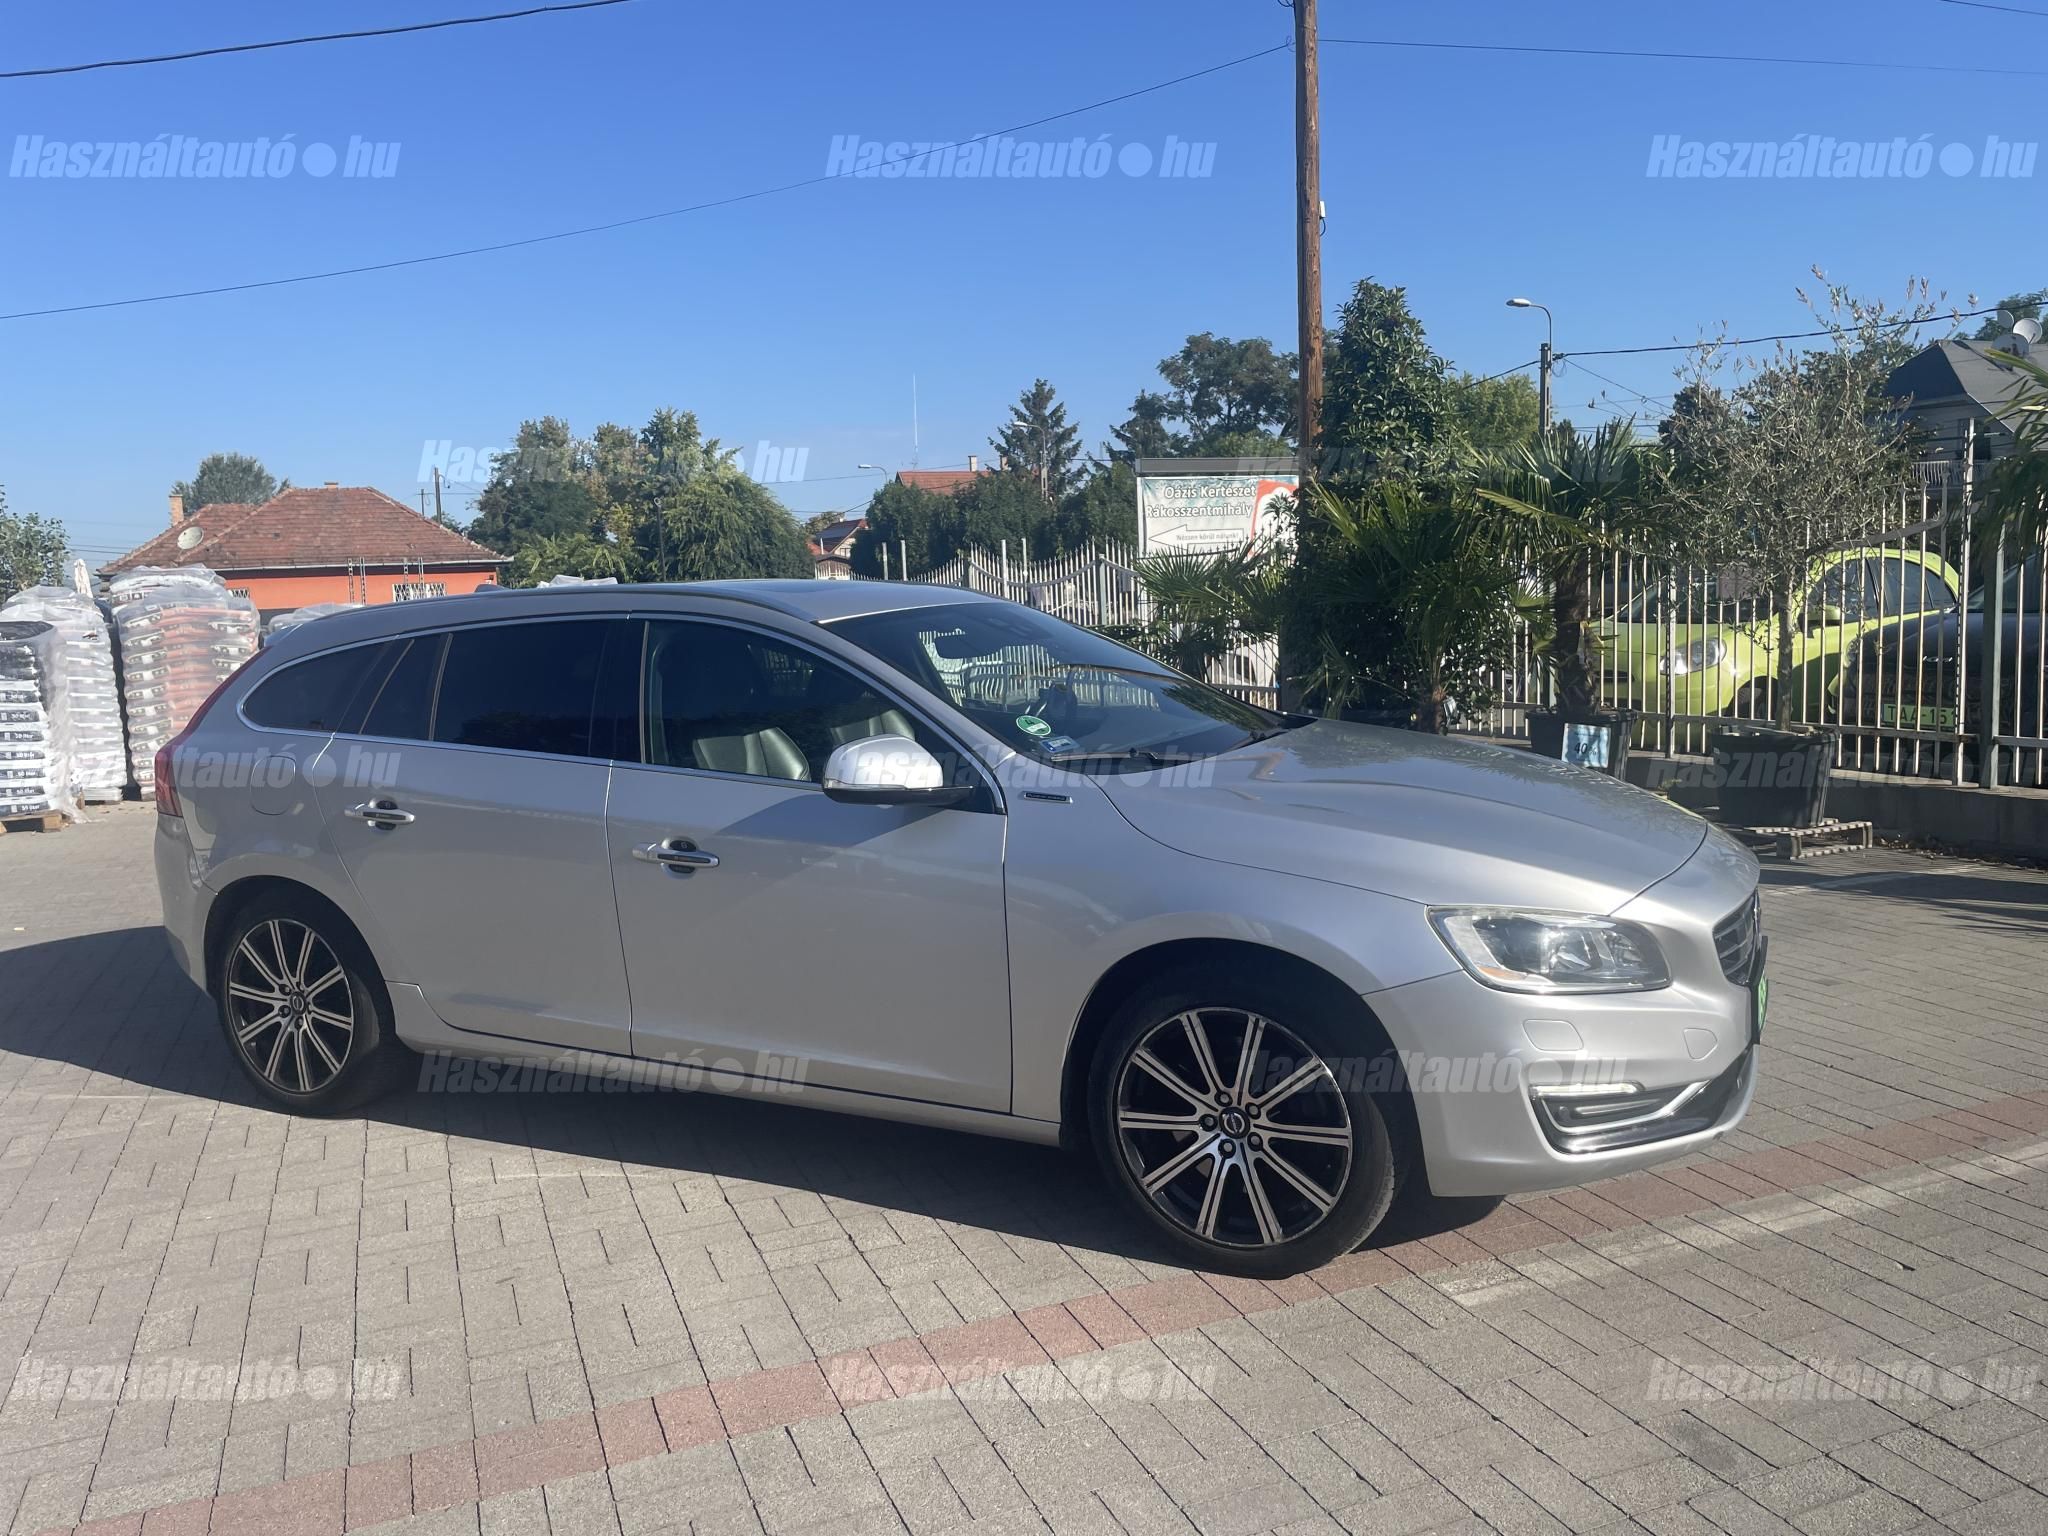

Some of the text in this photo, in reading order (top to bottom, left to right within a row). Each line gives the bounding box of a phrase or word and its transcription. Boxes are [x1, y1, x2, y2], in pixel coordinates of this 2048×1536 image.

[1164, 484, 1256, 499] Oázis Kertészet
[1146, 501, 1252, 518] Rákosszentmihály
